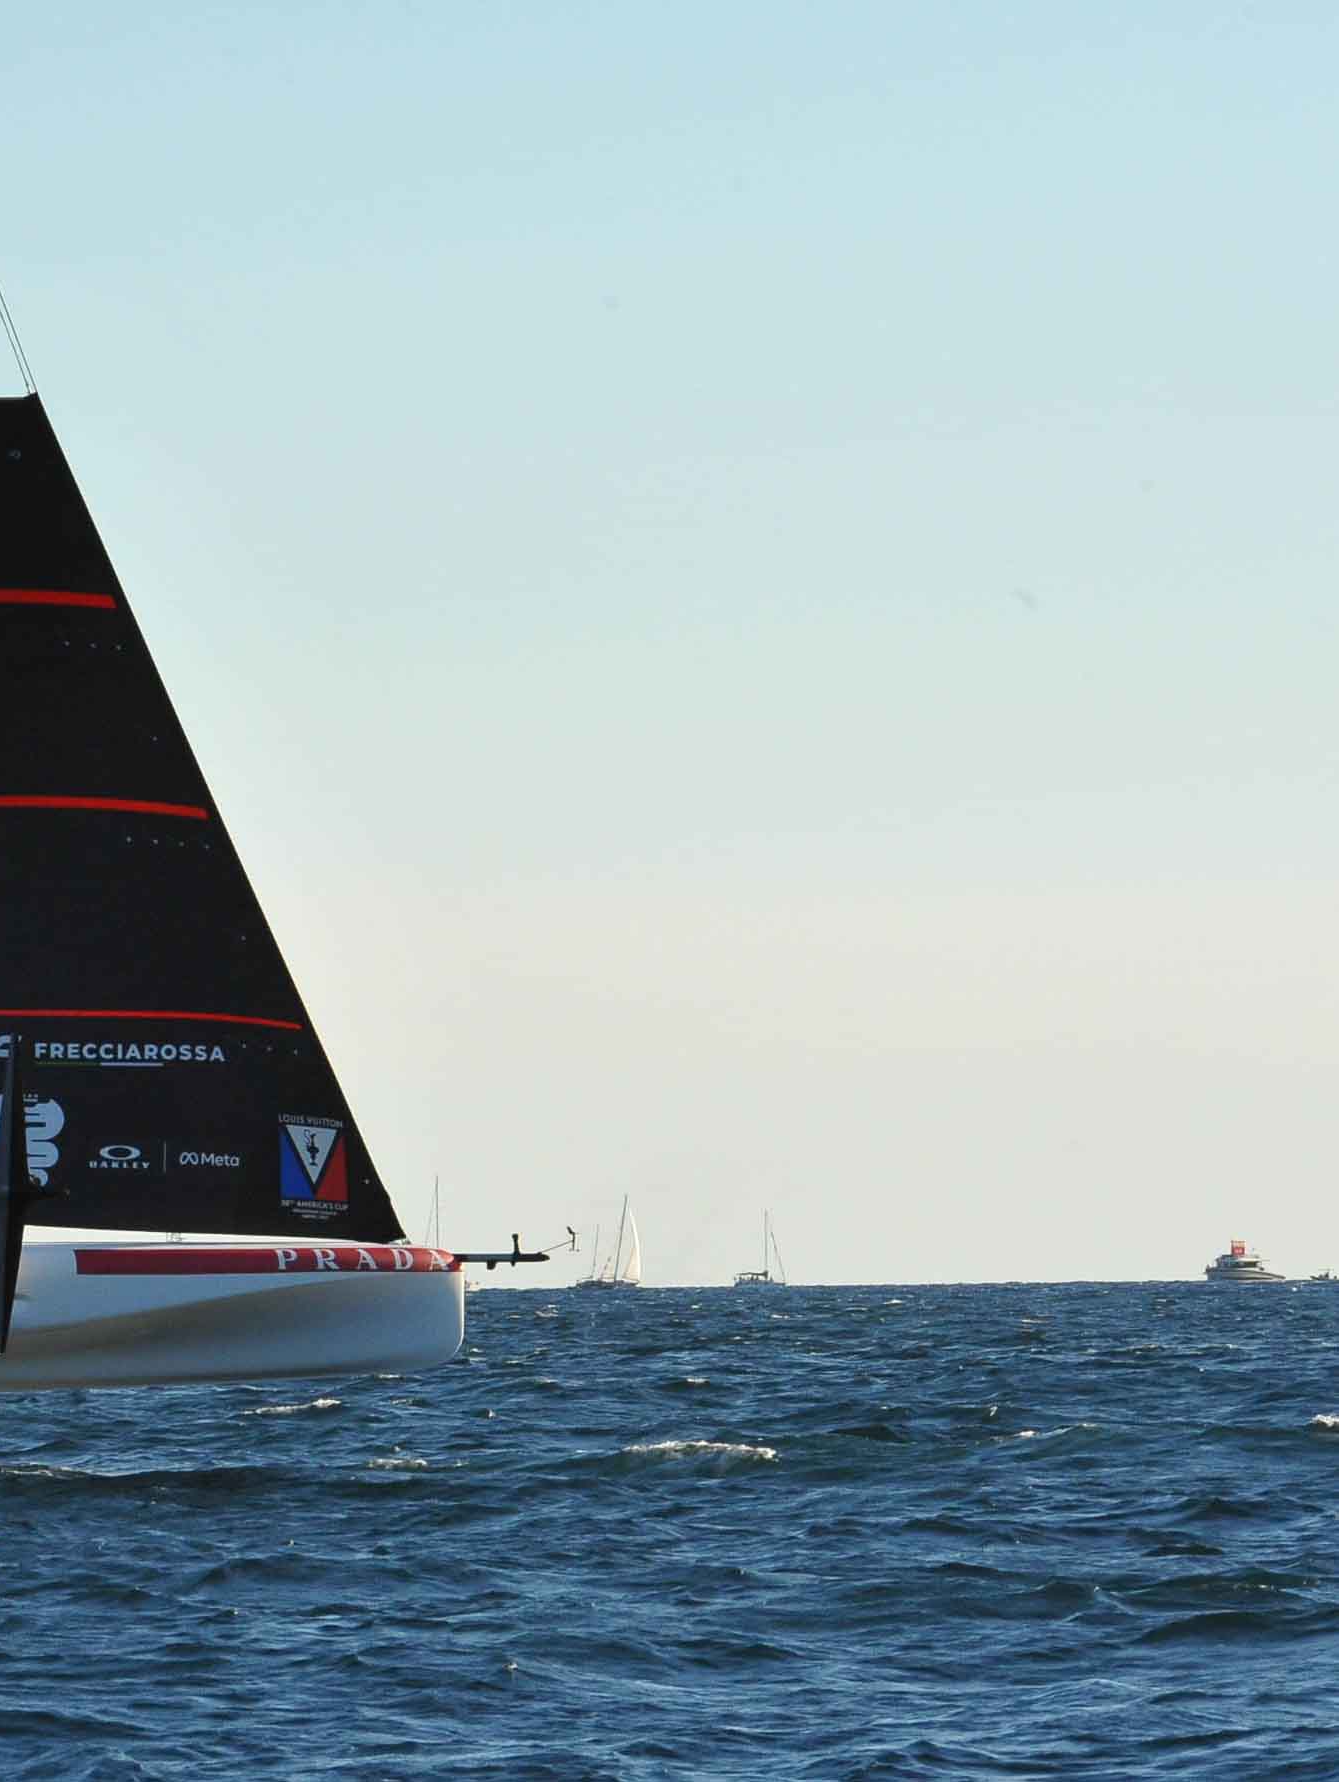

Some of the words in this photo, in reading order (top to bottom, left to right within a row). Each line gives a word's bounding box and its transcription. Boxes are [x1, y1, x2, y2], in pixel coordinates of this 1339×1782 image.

[34, 1042, 225, 1062] FRECCIAROSSA
[278, 1113, 304, 1124] LOUIS
[306, 1116, 343, 1128] VUITTON
[89, 1161, 150, 1169] OAKLEY
[200, 1151, 240, 1167] Meta
[275, 1249, 449, 1271] PRADA
